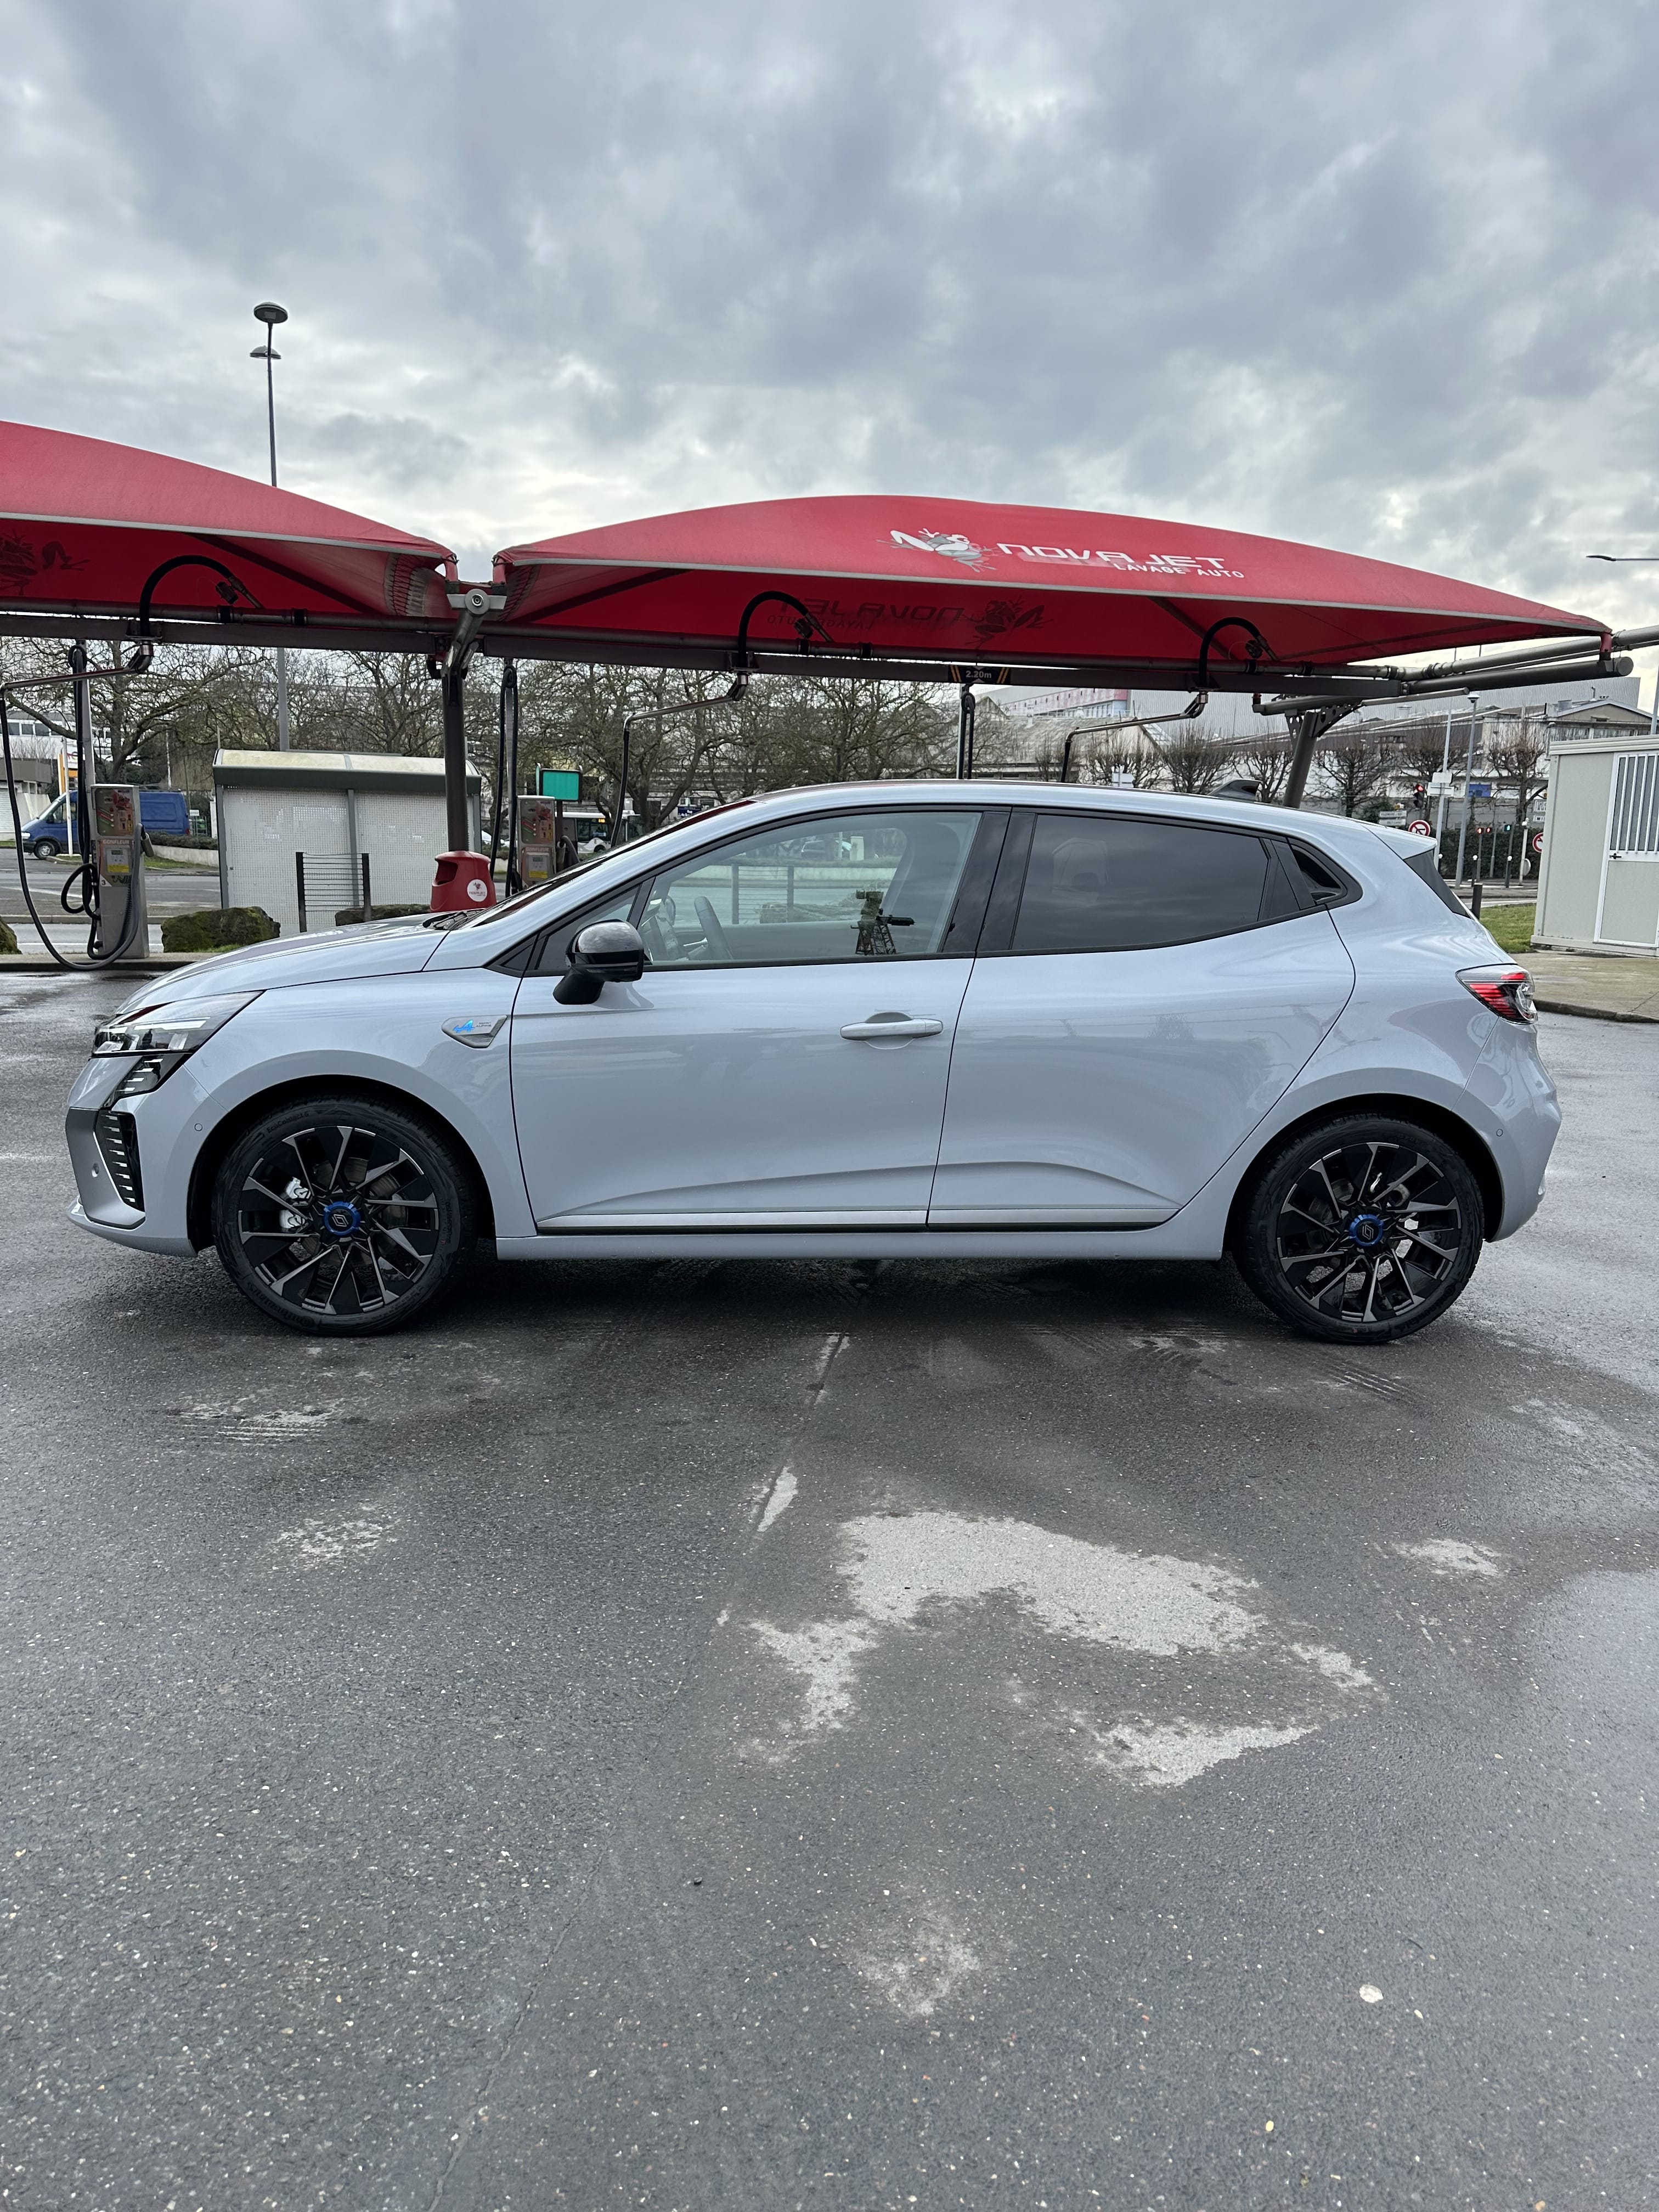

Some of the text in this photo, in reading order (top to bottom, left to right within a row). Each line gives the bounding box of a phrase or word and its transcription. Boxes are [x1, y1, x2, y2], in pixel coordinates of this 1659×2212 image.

[996, 543, 1225, 568] NOVA JET
[1114, 563, 1245, 578] LAVAGE AUTO
[966, 670, 991, 679] 2.20m
